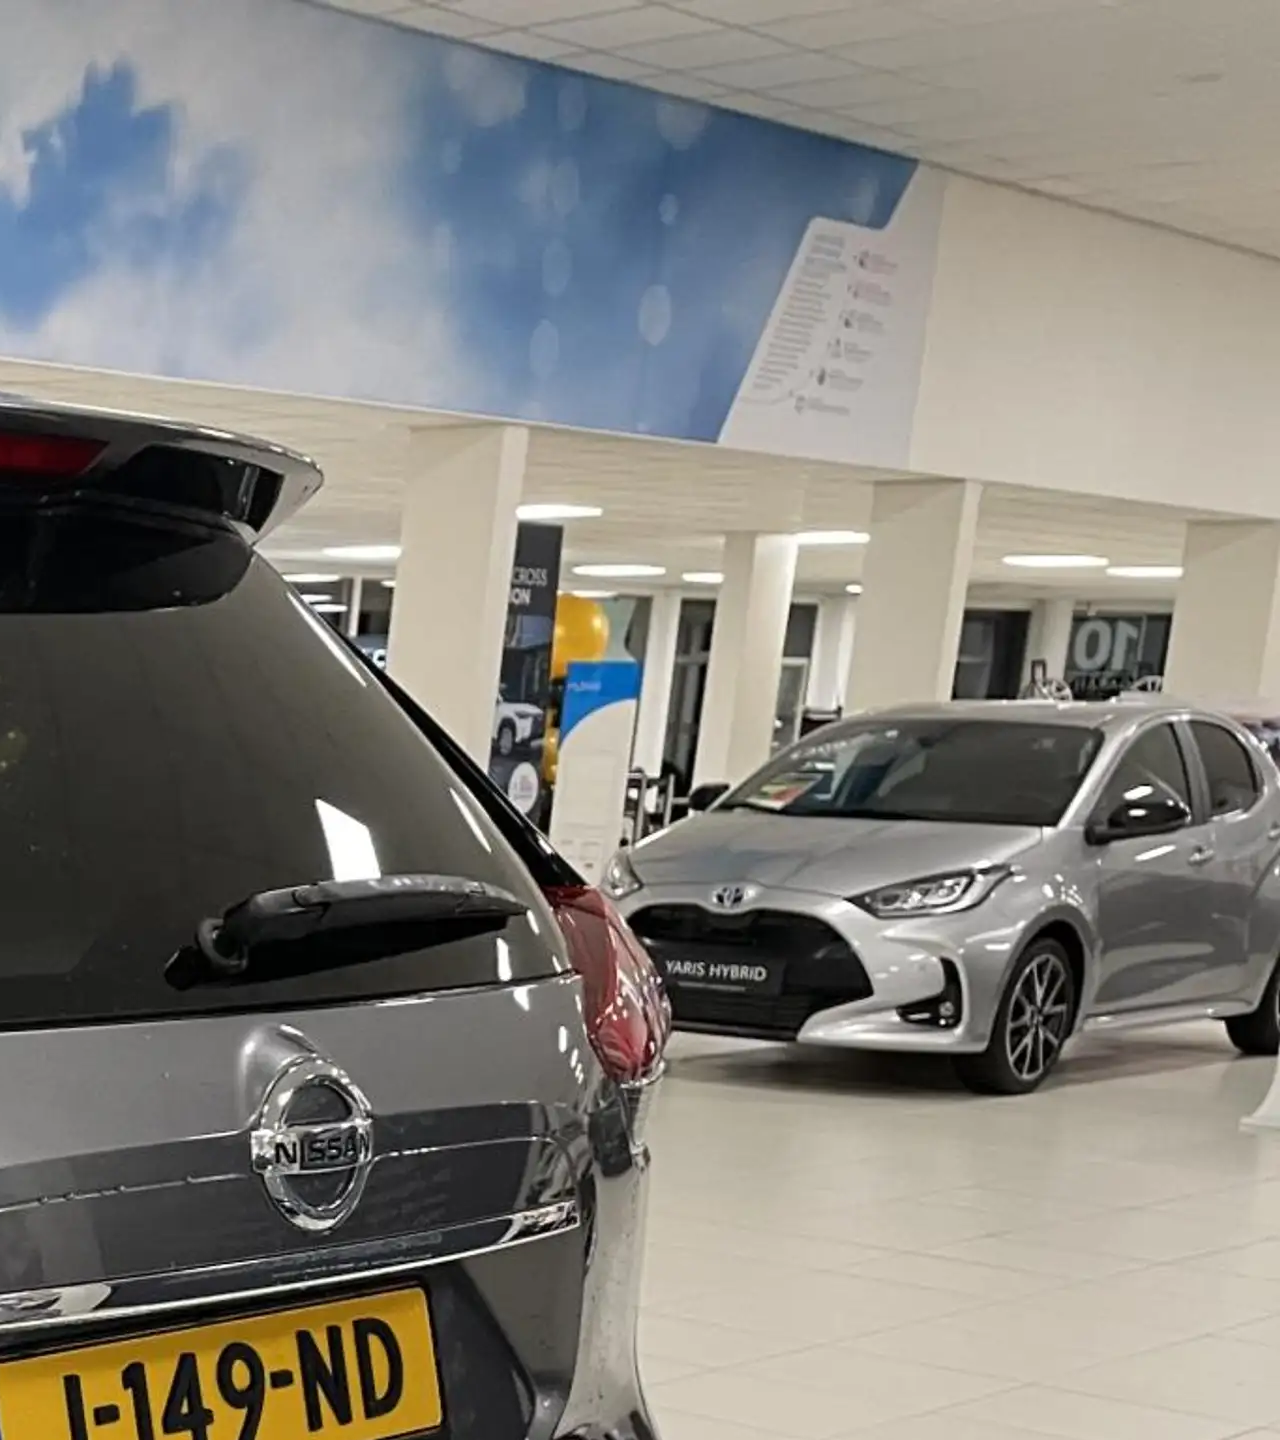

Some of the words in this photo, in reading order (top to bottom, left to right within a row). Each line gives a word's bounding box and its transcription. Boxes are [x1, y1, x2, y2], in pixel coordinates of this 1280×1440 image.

[665, 960, 706, 978] YARIS
[709, 963, 768, 982] HYBRID
[274, 1128, 371, 1168] NISSAN
